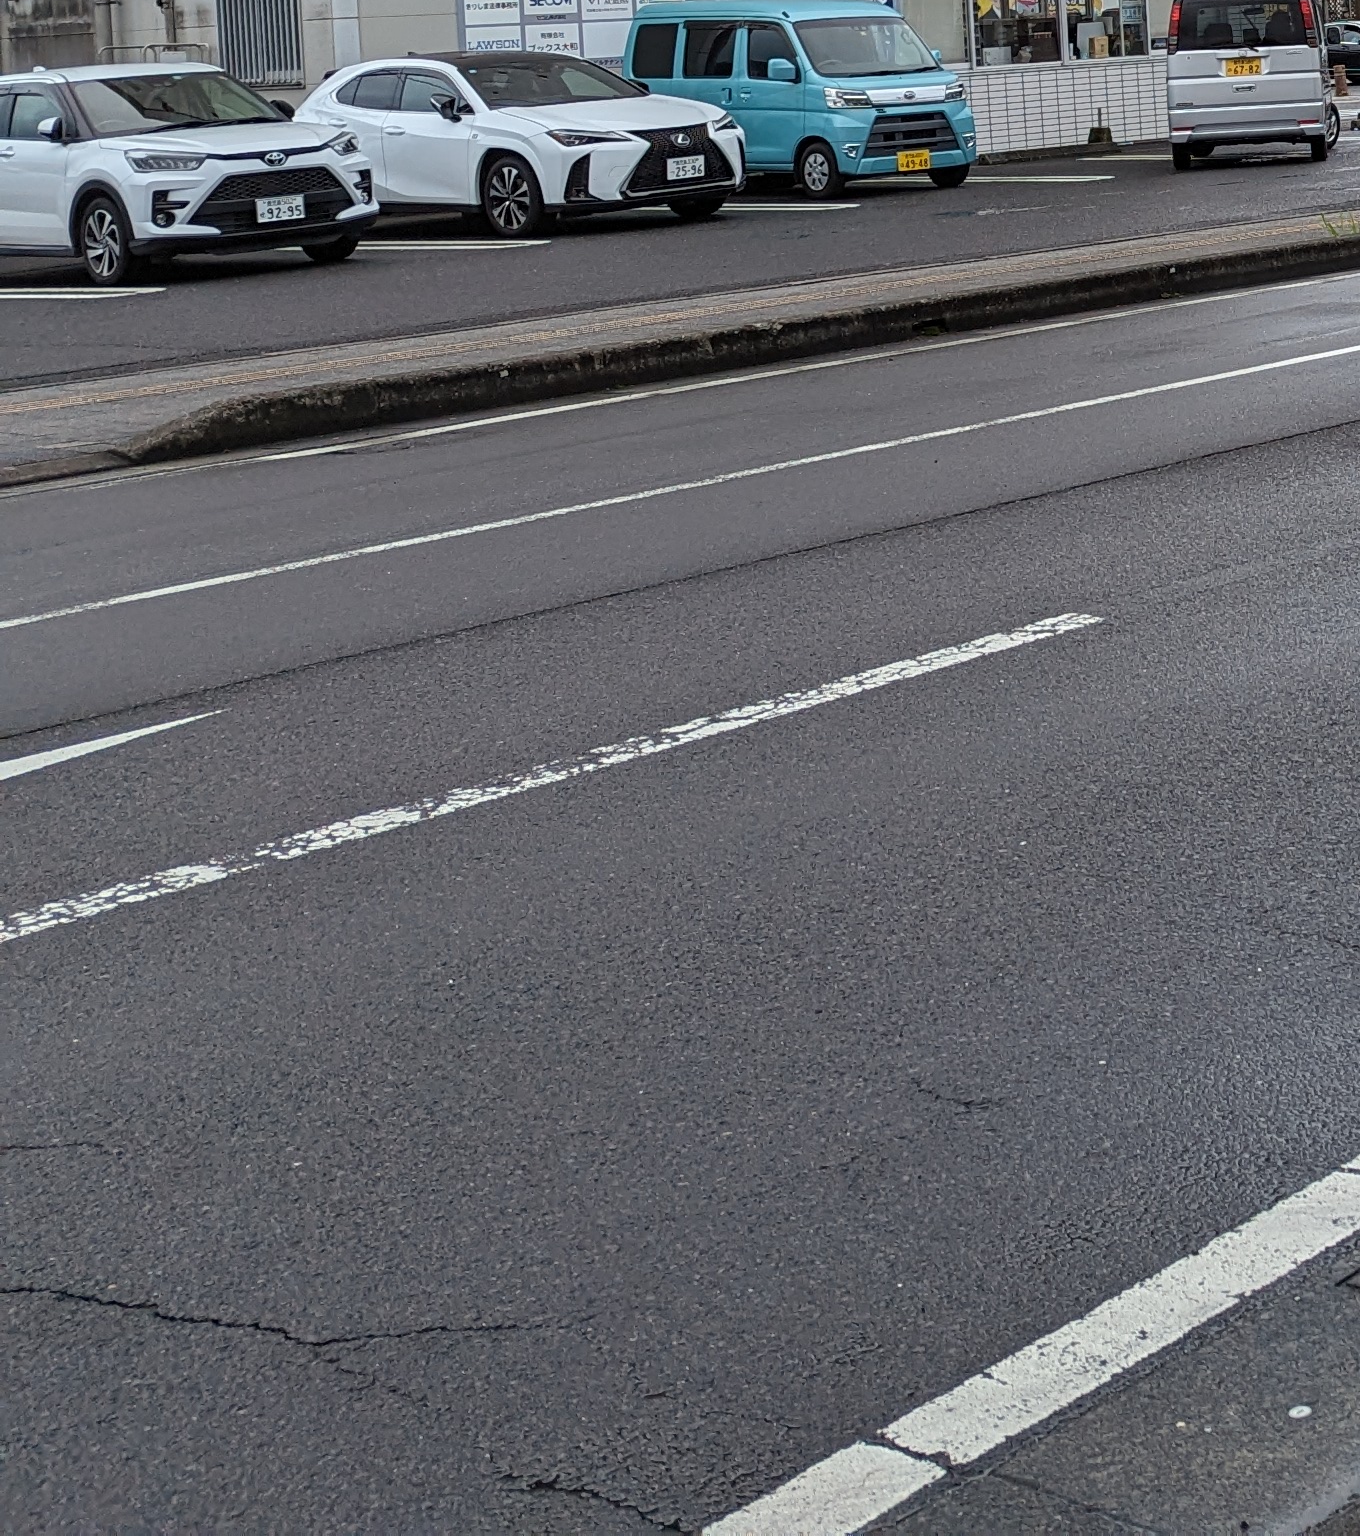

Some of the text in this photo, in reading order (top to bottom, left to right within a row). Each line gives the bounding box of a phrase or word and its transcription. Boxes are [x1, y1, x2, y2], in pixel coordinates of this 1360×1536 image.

[467, 39, 521, 50] LAWSON
[1233, 64, 1260, 75] 67-82
[675, 163, 703, 177] 25-96
[267, 204, 302, 220] 92-95
